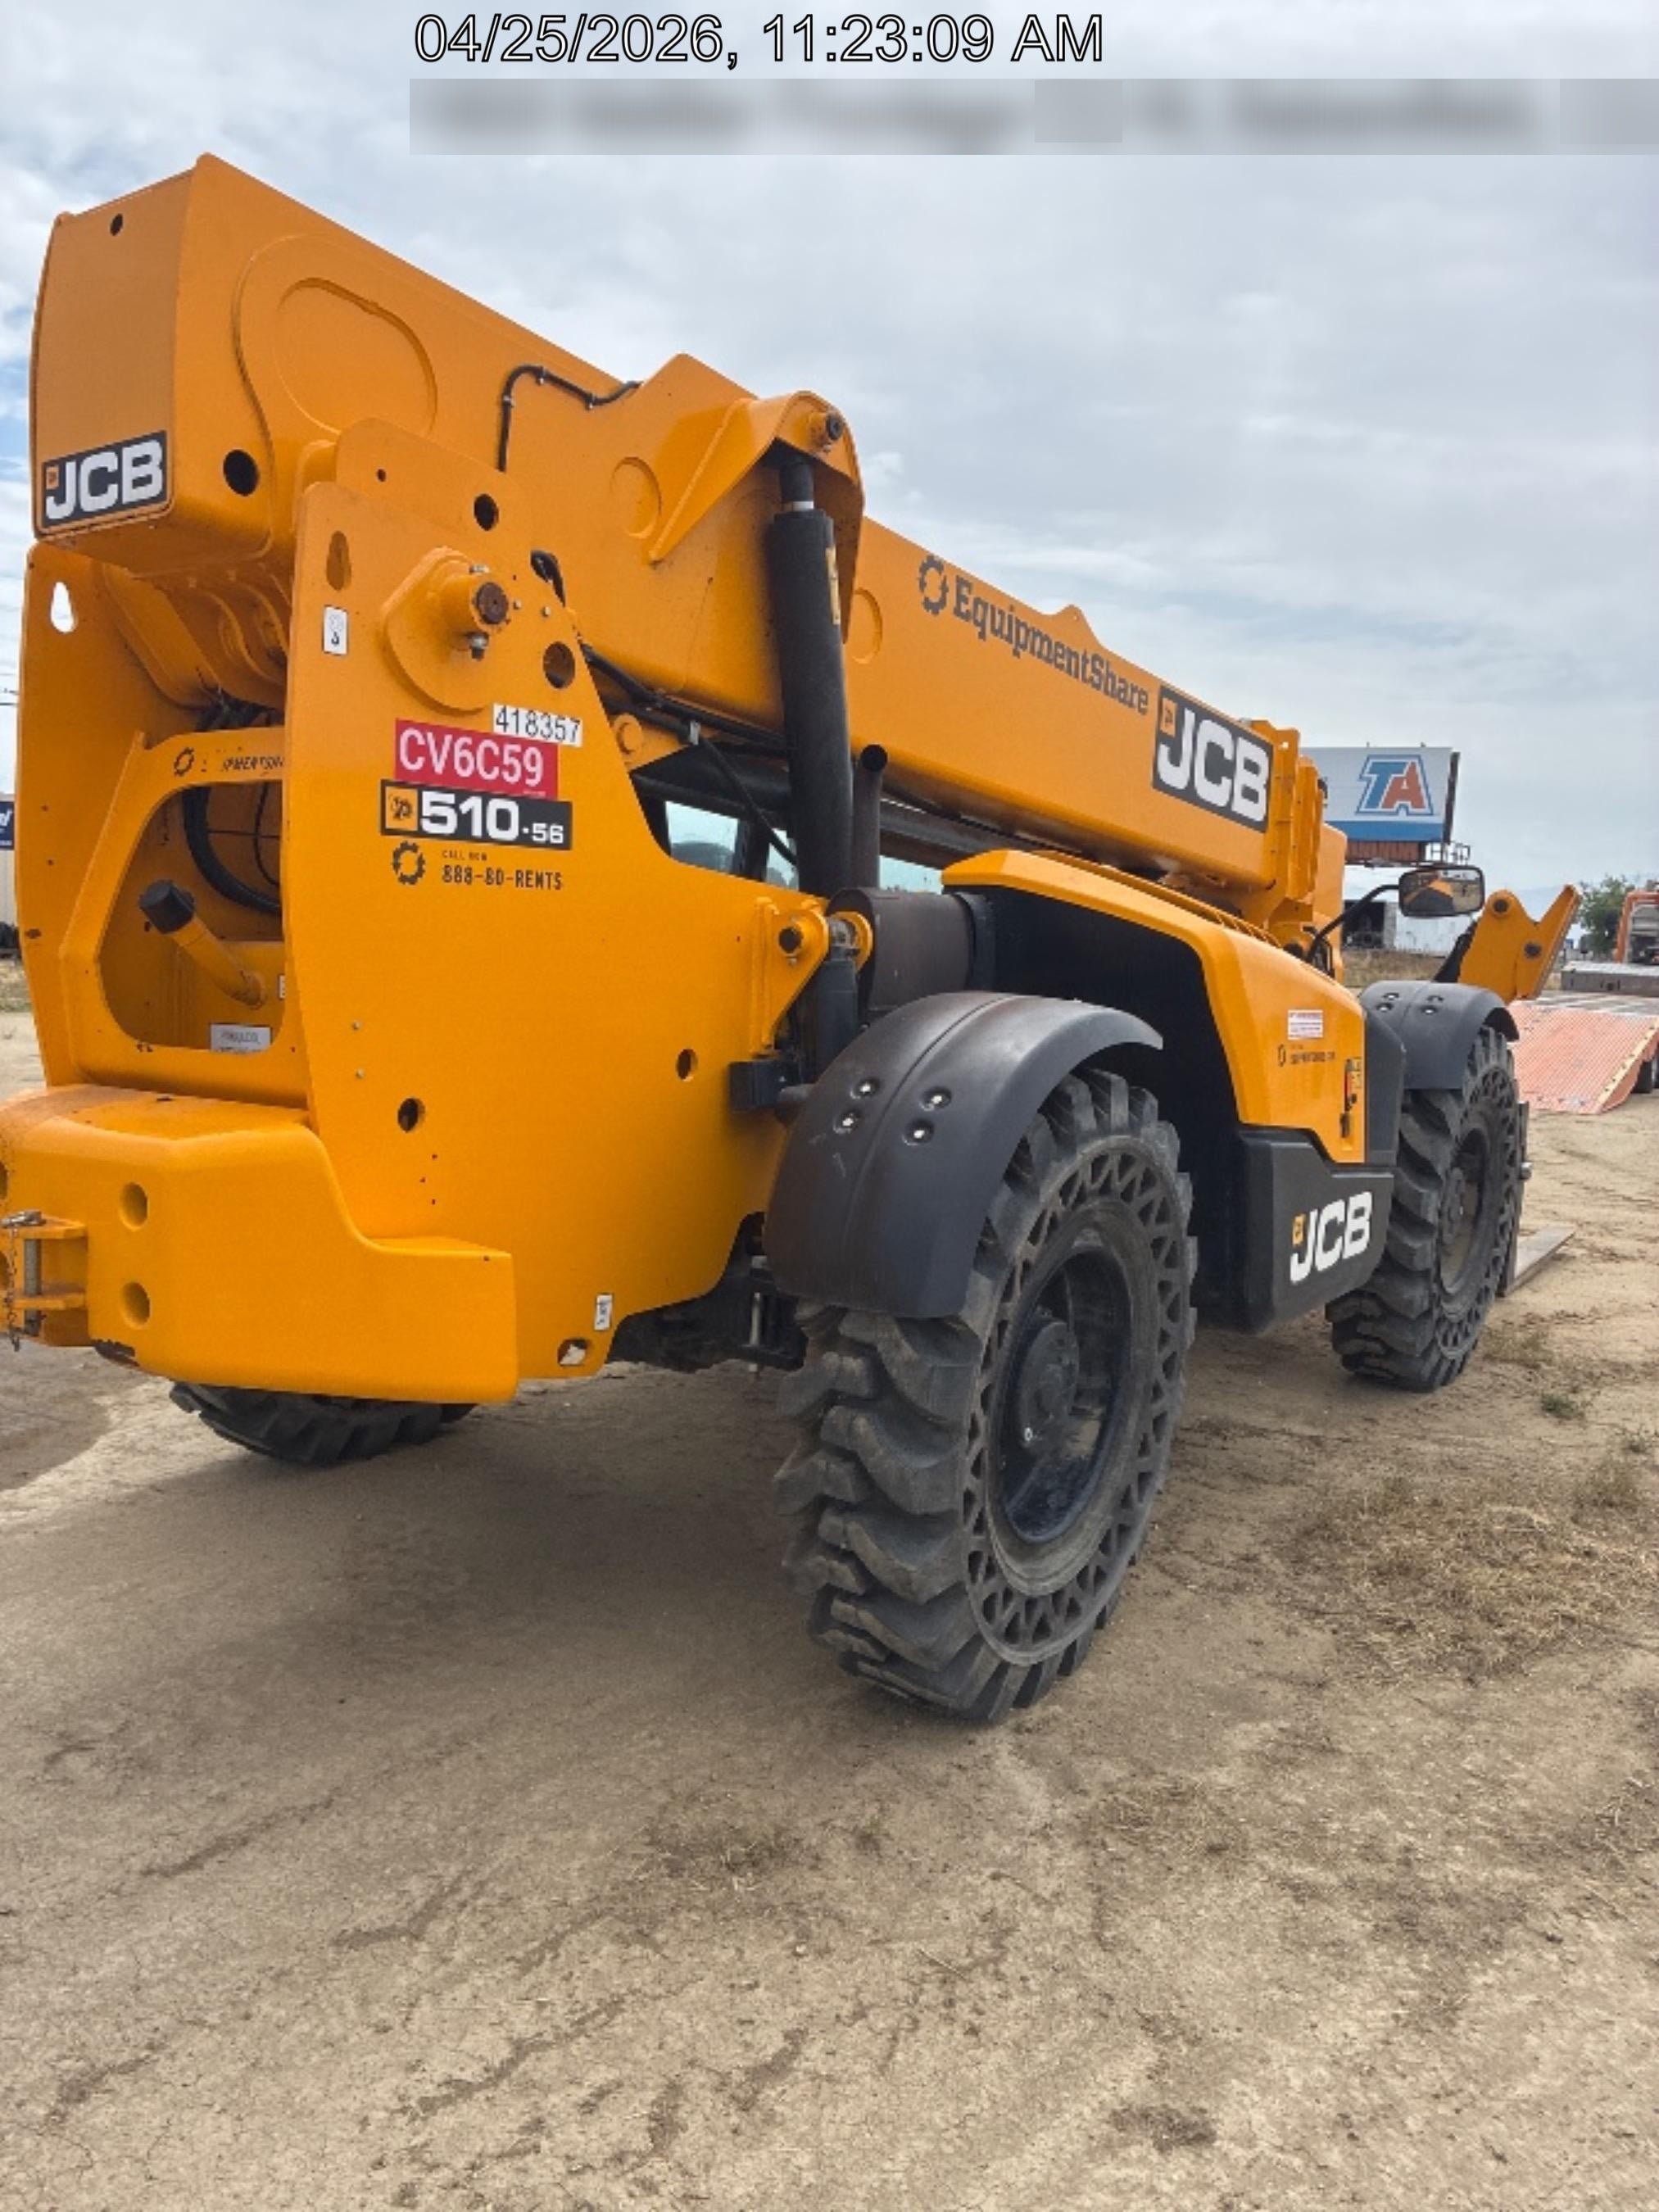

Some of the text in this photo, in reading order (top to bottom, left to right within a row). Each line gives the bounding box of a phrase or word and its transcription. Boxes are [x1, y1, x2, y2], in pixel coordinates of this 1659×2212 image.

[45, 439, 163, 519] JCB
[953, 575, 1149, 715] EquipmentShare
[399, 728, 544, 787] CV6C59
[496, 705, 581, 742] 418357
[1157, 708, 1268, 823] JCB
[1360, 757, 1430, 813] TA
[1290, 1191, 1373, 1285] JCB
